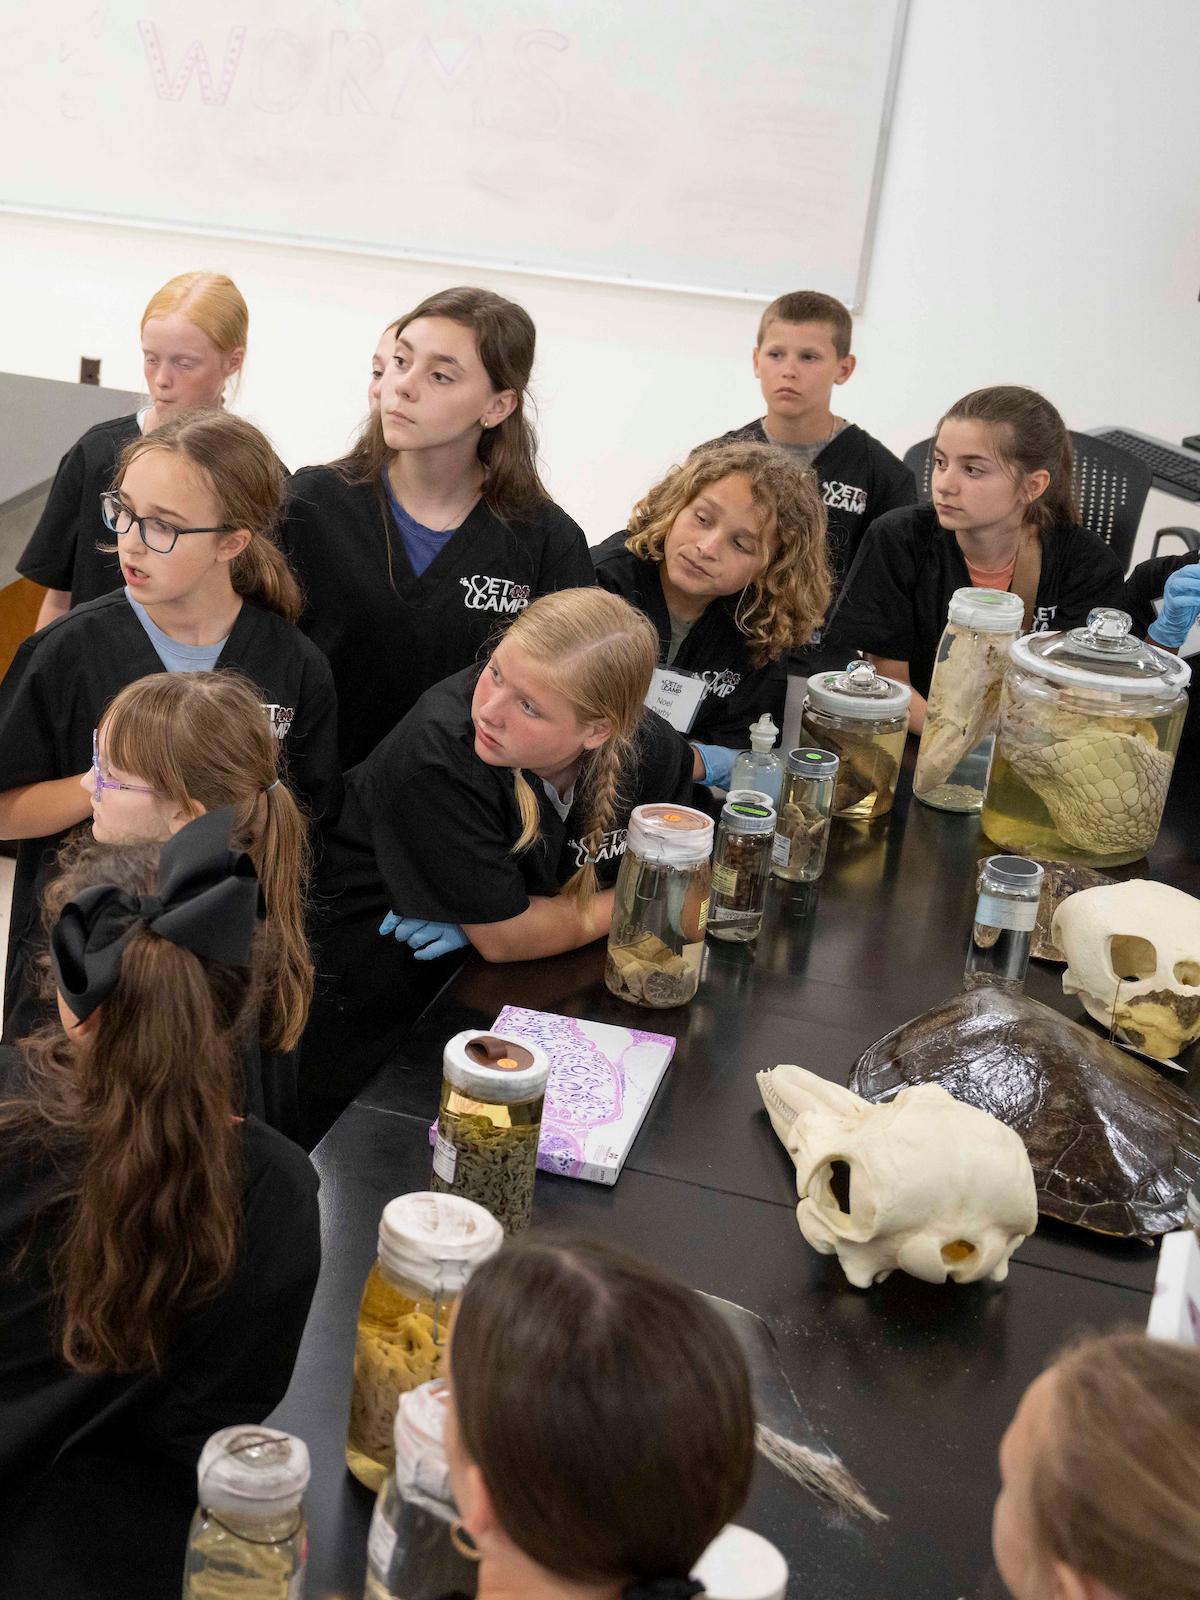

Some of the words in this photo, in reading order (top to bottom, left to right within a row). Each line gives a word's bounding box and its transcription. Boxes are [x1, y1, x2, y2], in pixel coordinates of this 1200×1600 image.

[135, 19, 572, 142] WORMS
[470, 575, 515, 597] VET
[472, 593, 529, 613] CAMP
[657, 697, 674, 707] Noel
